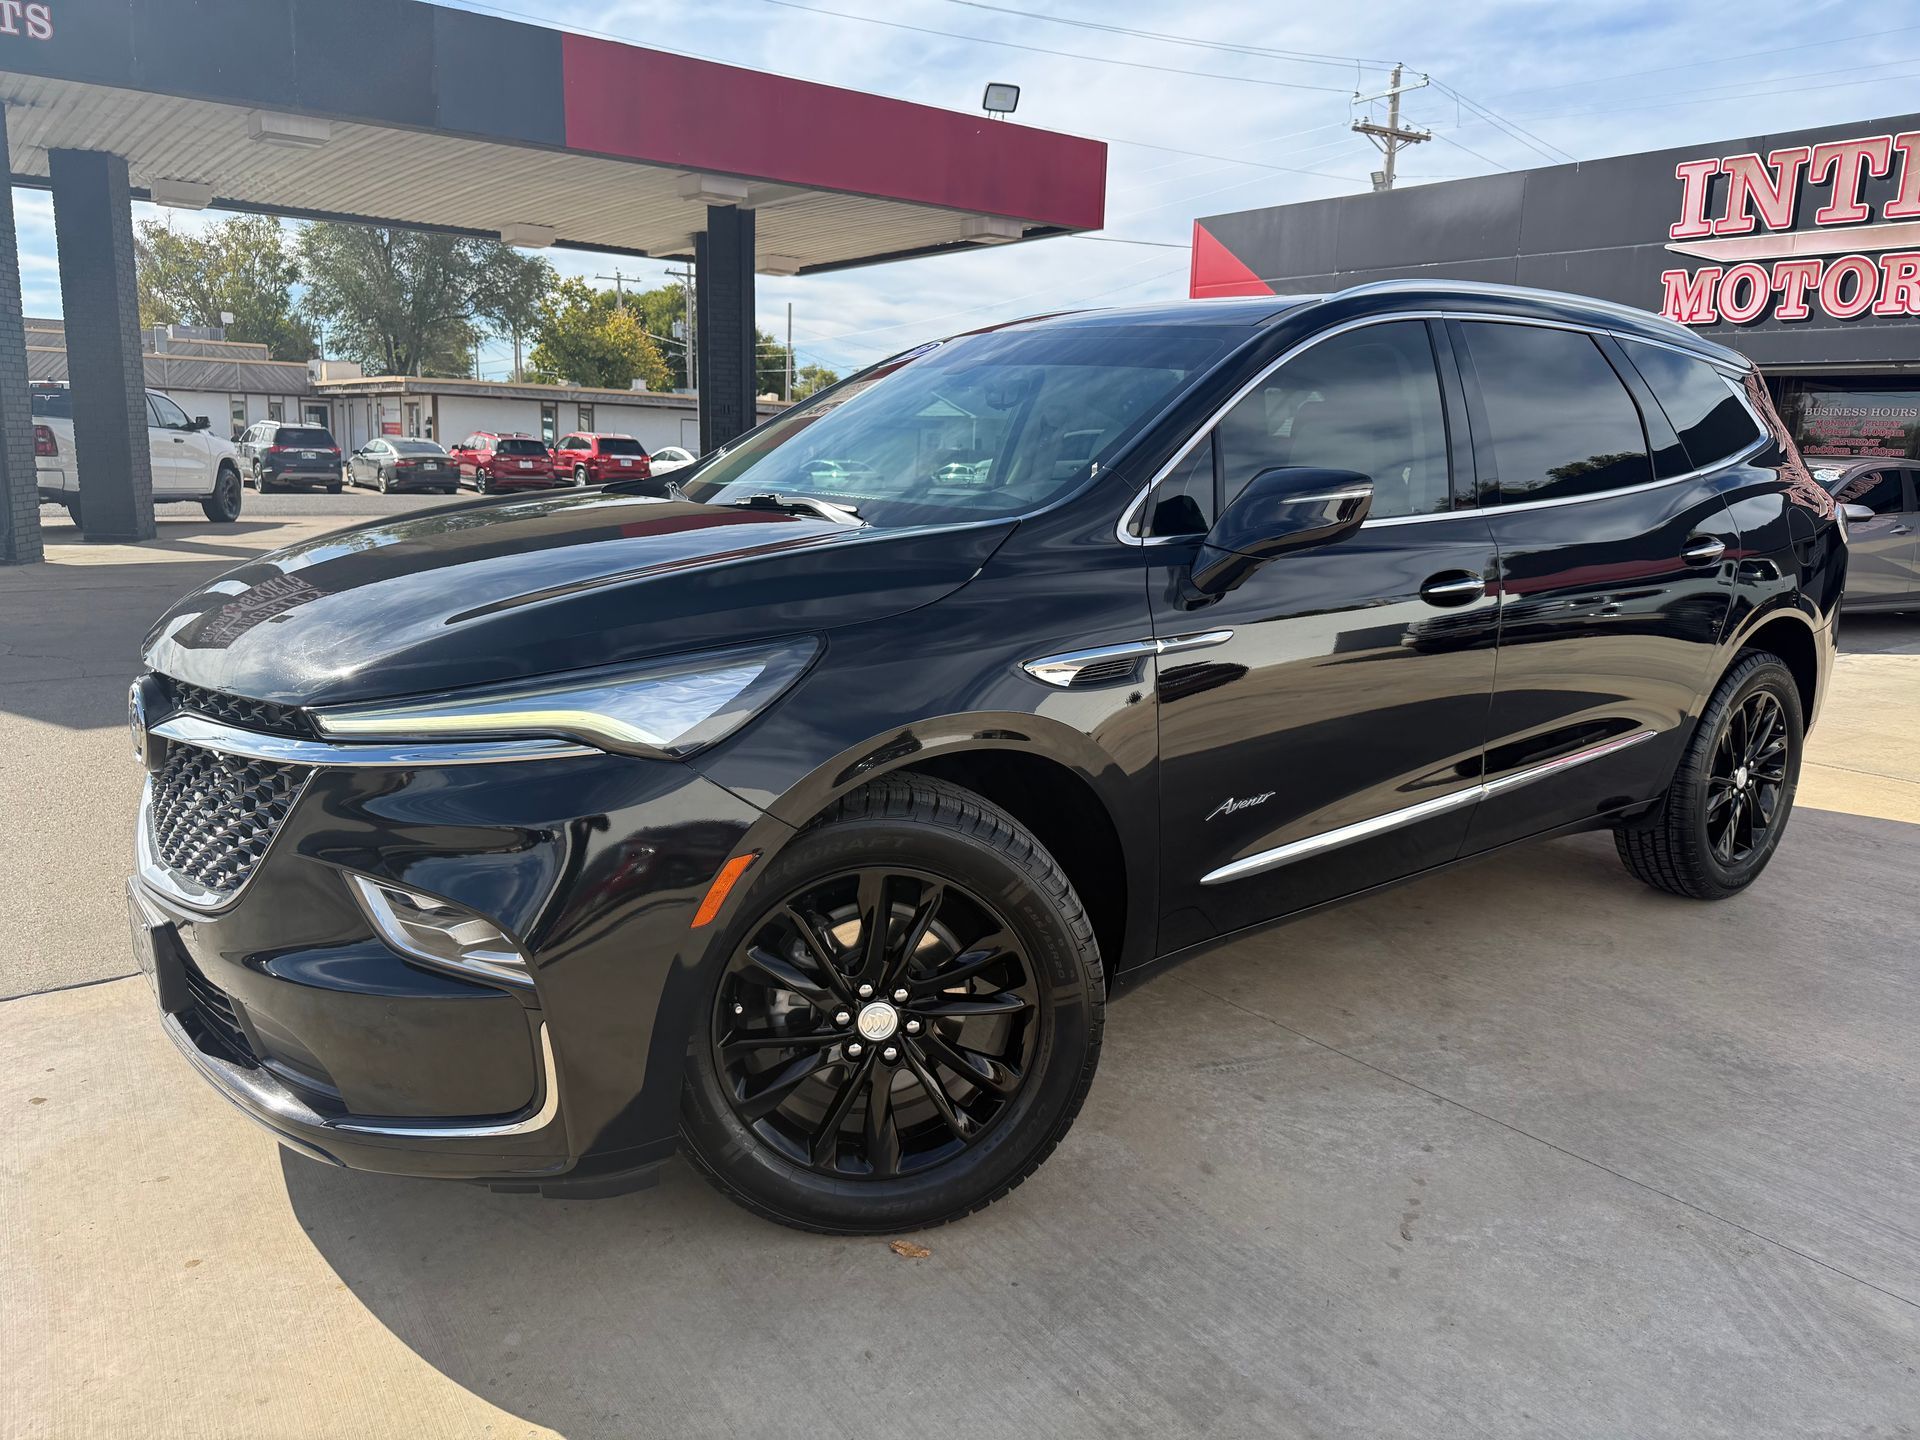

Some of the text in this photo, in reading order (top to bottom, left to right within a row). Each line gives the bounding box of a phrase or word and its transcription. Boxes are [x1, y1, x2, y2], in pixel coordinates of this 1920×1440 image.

[1804, 407, 1918, 418] BUSINESS HOURS
[1205, 791, 1276, 821] Avenir
